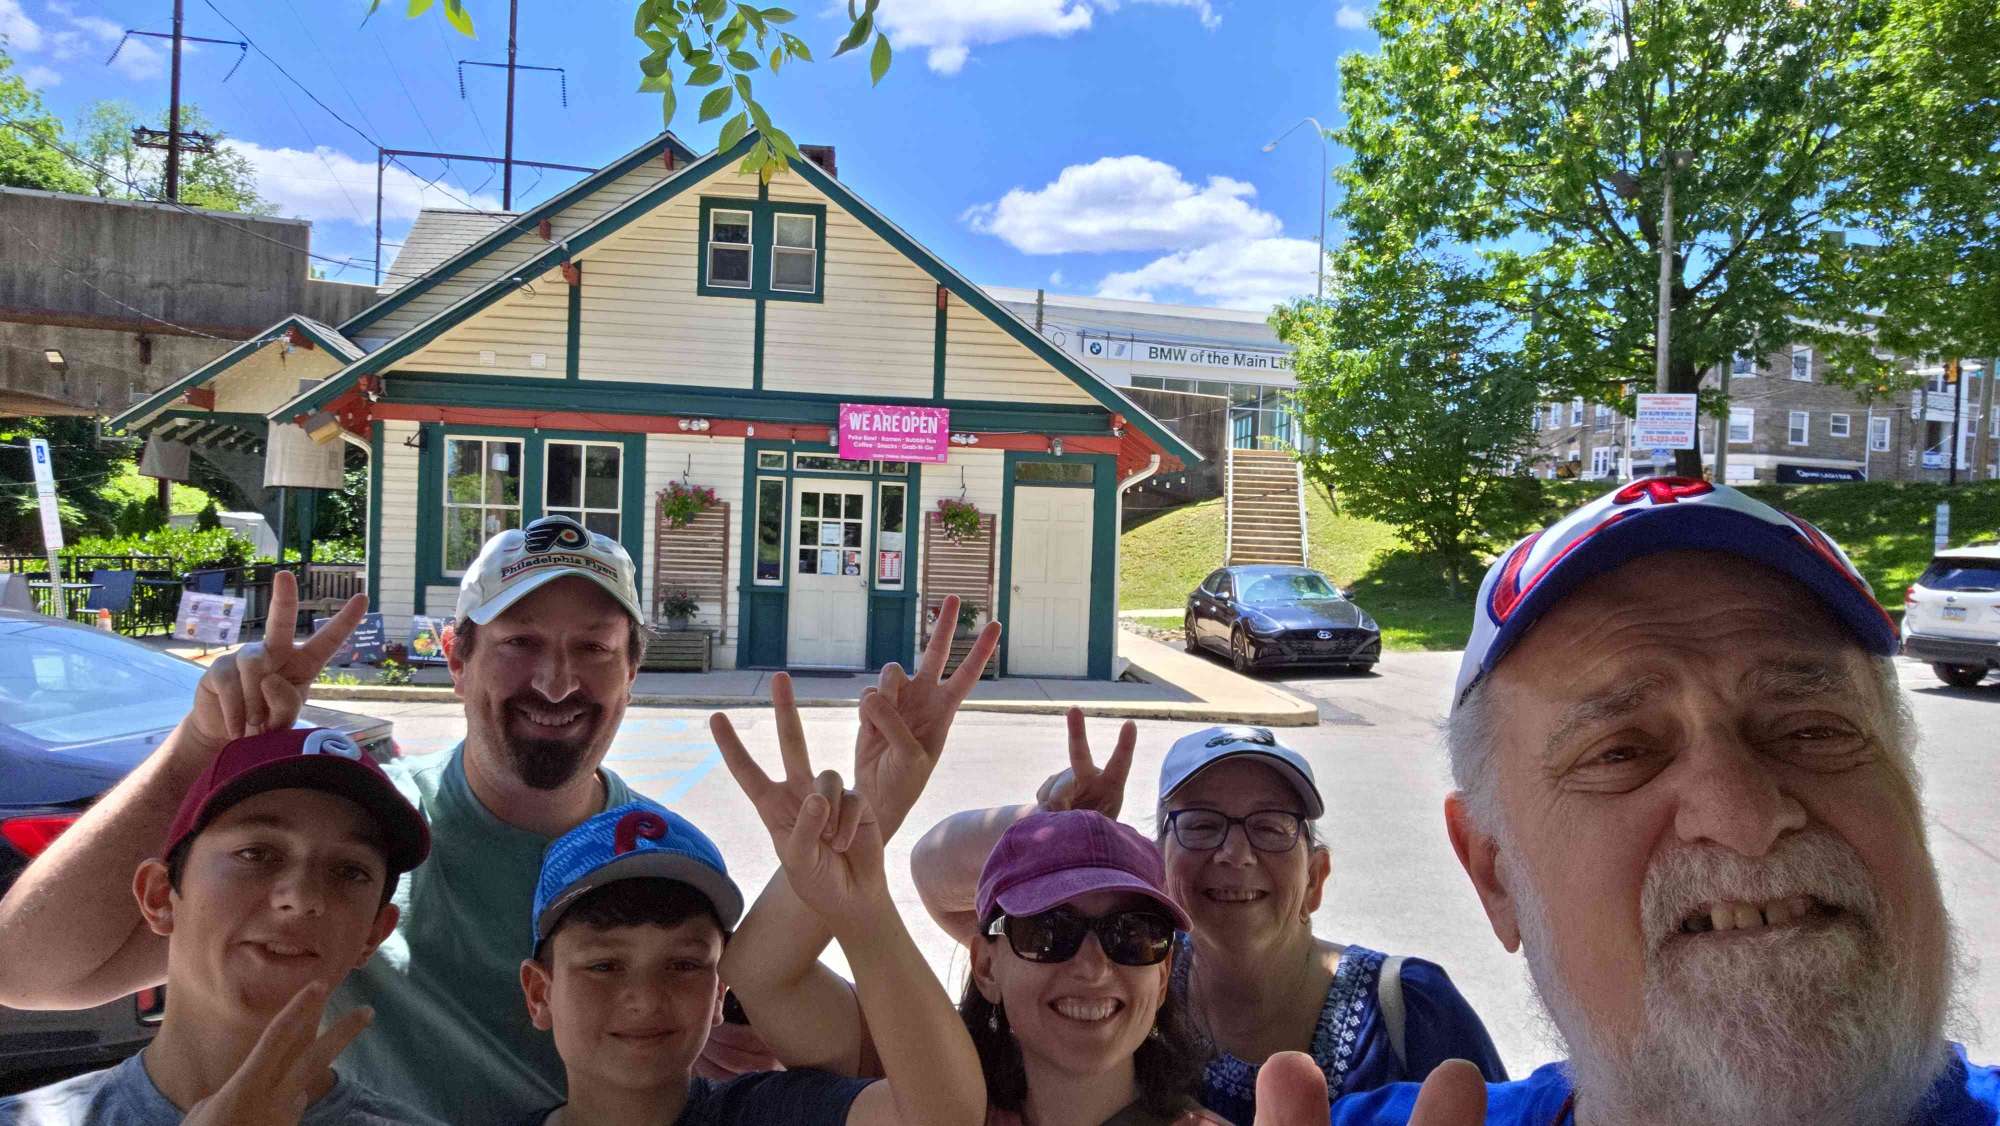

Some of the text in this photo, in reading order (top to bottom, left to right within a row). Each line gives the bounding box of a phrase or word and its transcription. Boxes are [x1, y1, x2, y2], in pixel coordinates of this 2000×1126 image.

[1149, 346, 1186, 361] BMW
[1190, 350, 1205, 363] of
[1207, 351, 1230, 365] the
[1234, 354, 1267, 368] Main
[849, 412, 938, 434] WE ARE OPEN
[501, 555, 618, 579] Philadelphia Flyers
